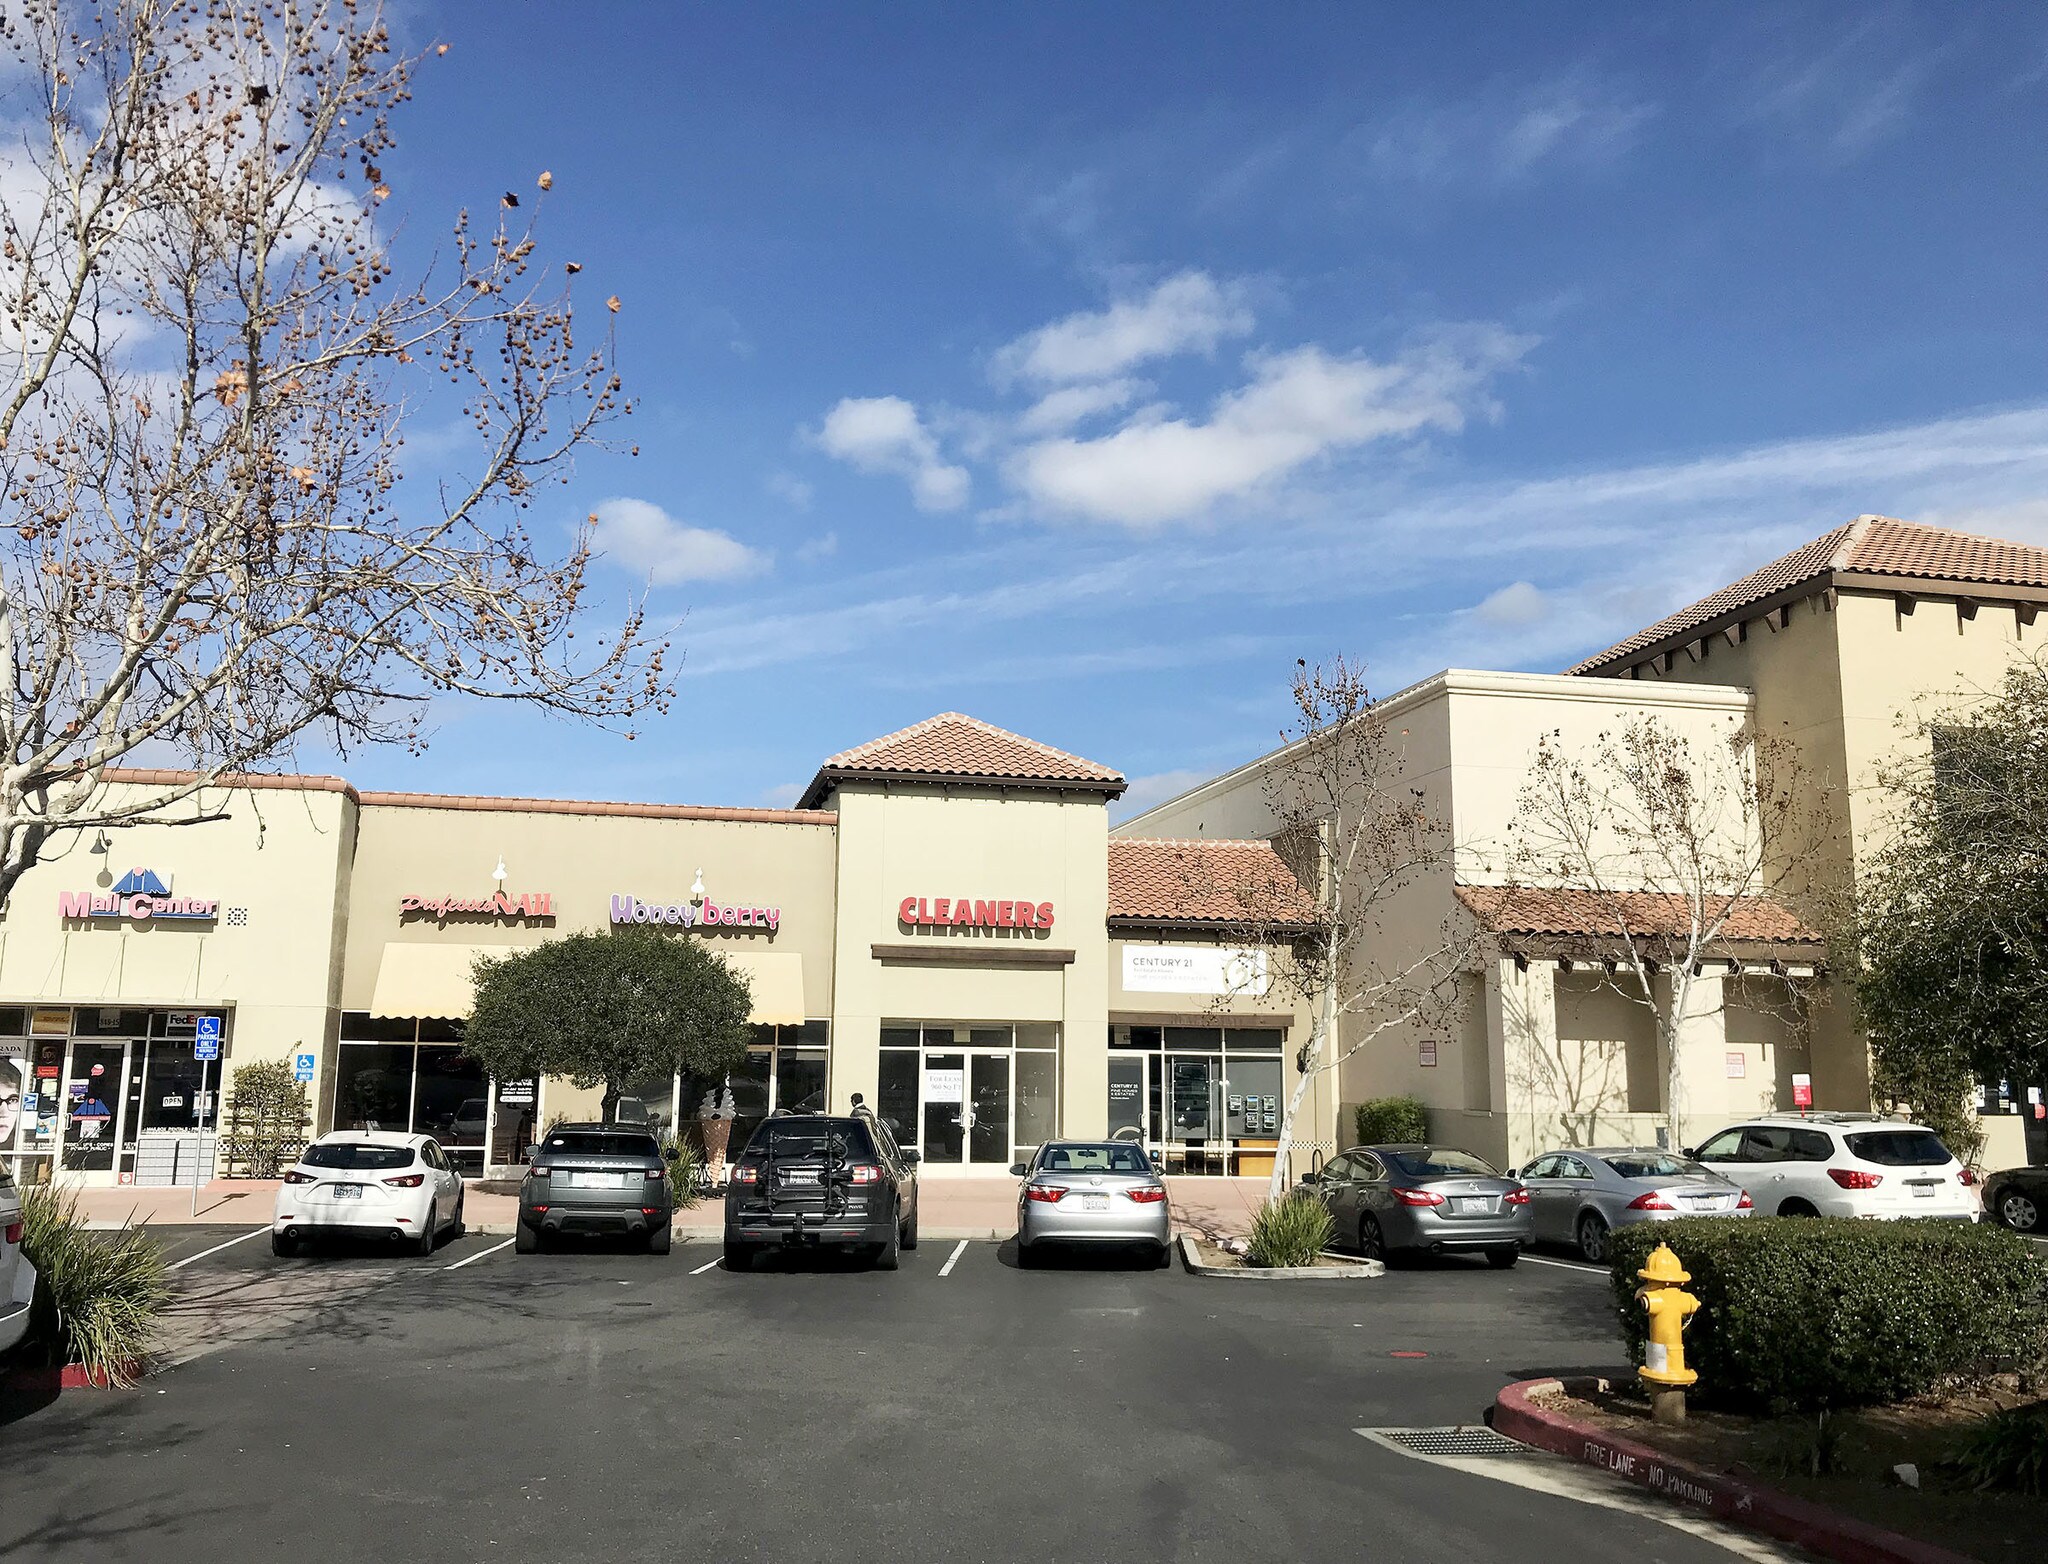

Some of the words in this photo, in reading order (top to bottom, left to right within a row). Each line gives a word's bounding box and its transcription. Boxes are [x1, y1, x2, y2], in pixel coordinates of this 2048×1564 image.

[58, 891, 120, 918] Mail
[128, 893, 217, 919] Center
[610, 893, 696, 928] Honey
[702, 895, 781, 930] berry
[899, 897, 1055, 929] CLEANERS
[1132, 957, 1181, 968] CENTURY
[1184, 959, 1193, 968] 21
[170, 1014, 198, 1025] FedE
[164, 1098, 182, 1106] OPEN
[1584, 1441, 1606, 1465] FIRE
[1609, 1450, 1636, 1476] LANE
[1649, 1464, 1664, 1487] NO
[1667, 1474, 1713, 1505] PARKING
